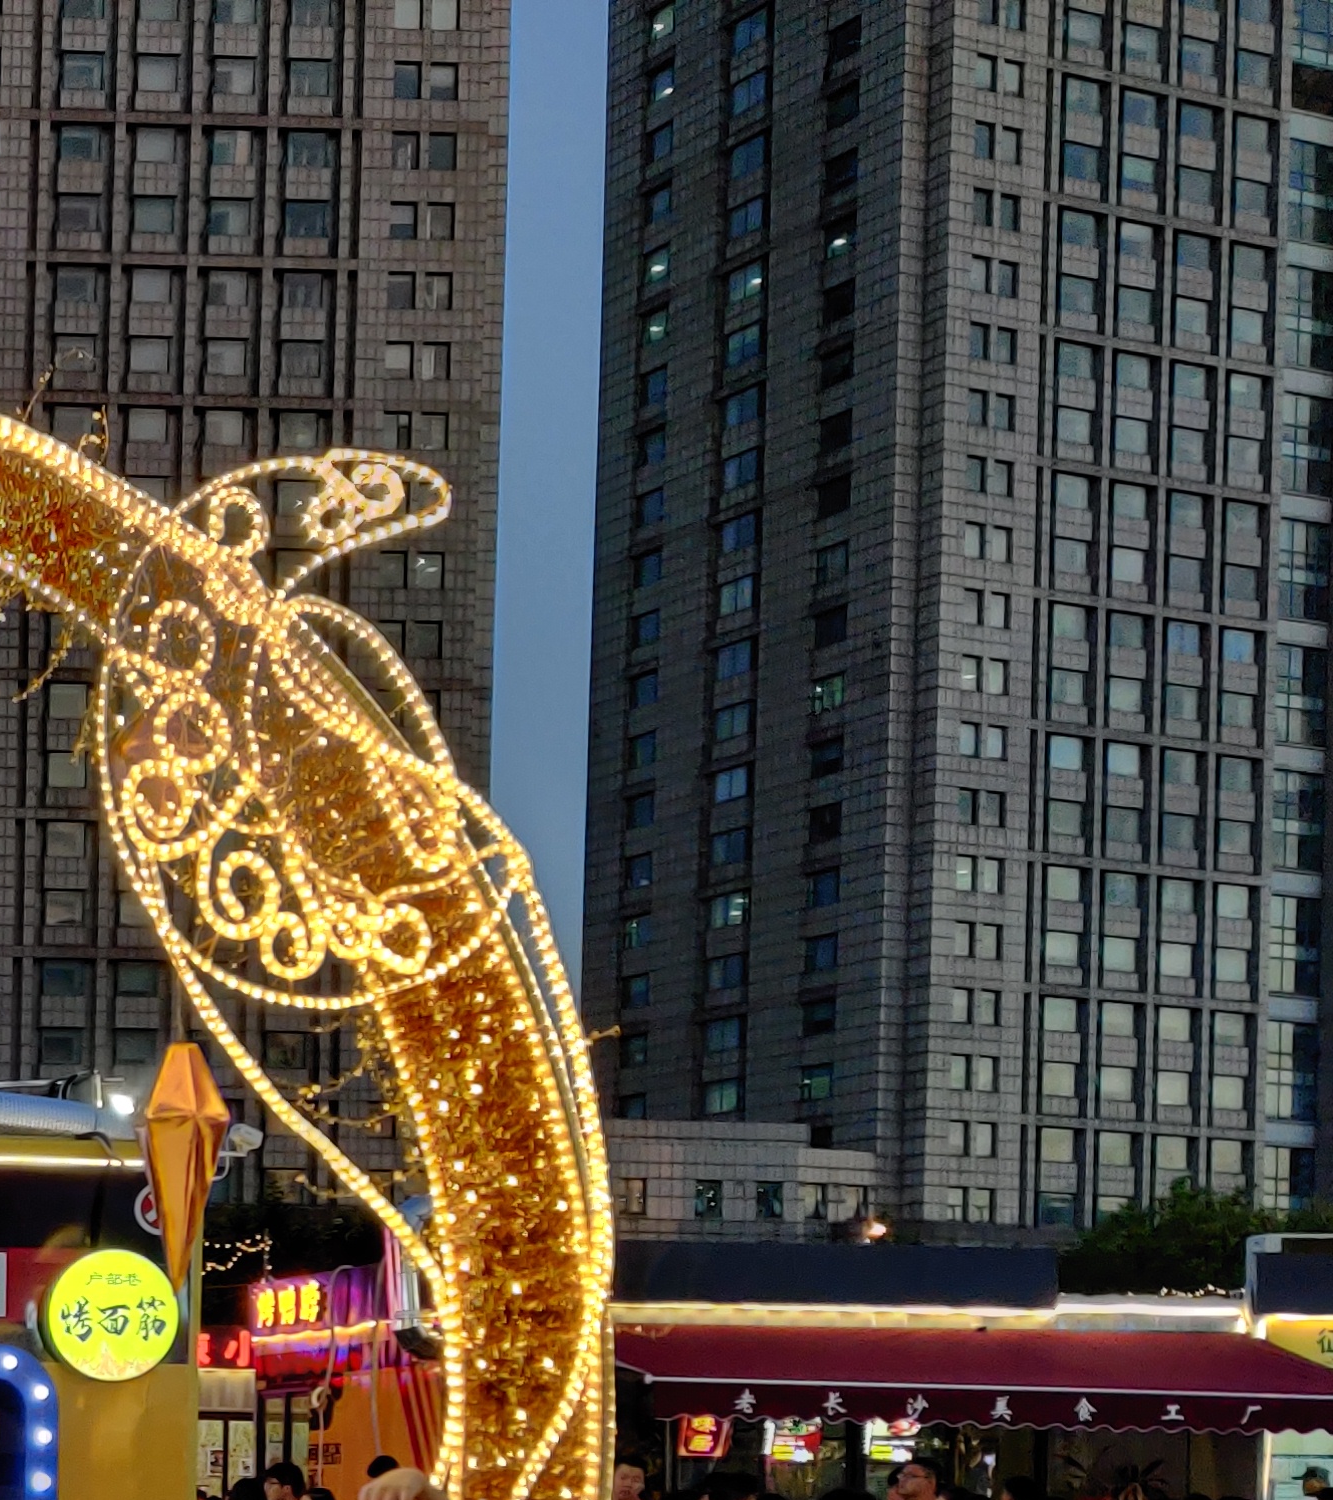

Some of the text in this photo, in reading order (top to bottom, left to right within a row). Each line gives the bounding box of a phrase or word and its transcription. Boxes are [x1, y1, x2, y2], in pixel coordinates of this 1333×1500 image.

[59, 1295, 167, 1342] 烤面筋
[734, 1388, 1263, 1425] 老长沙美食工厂
